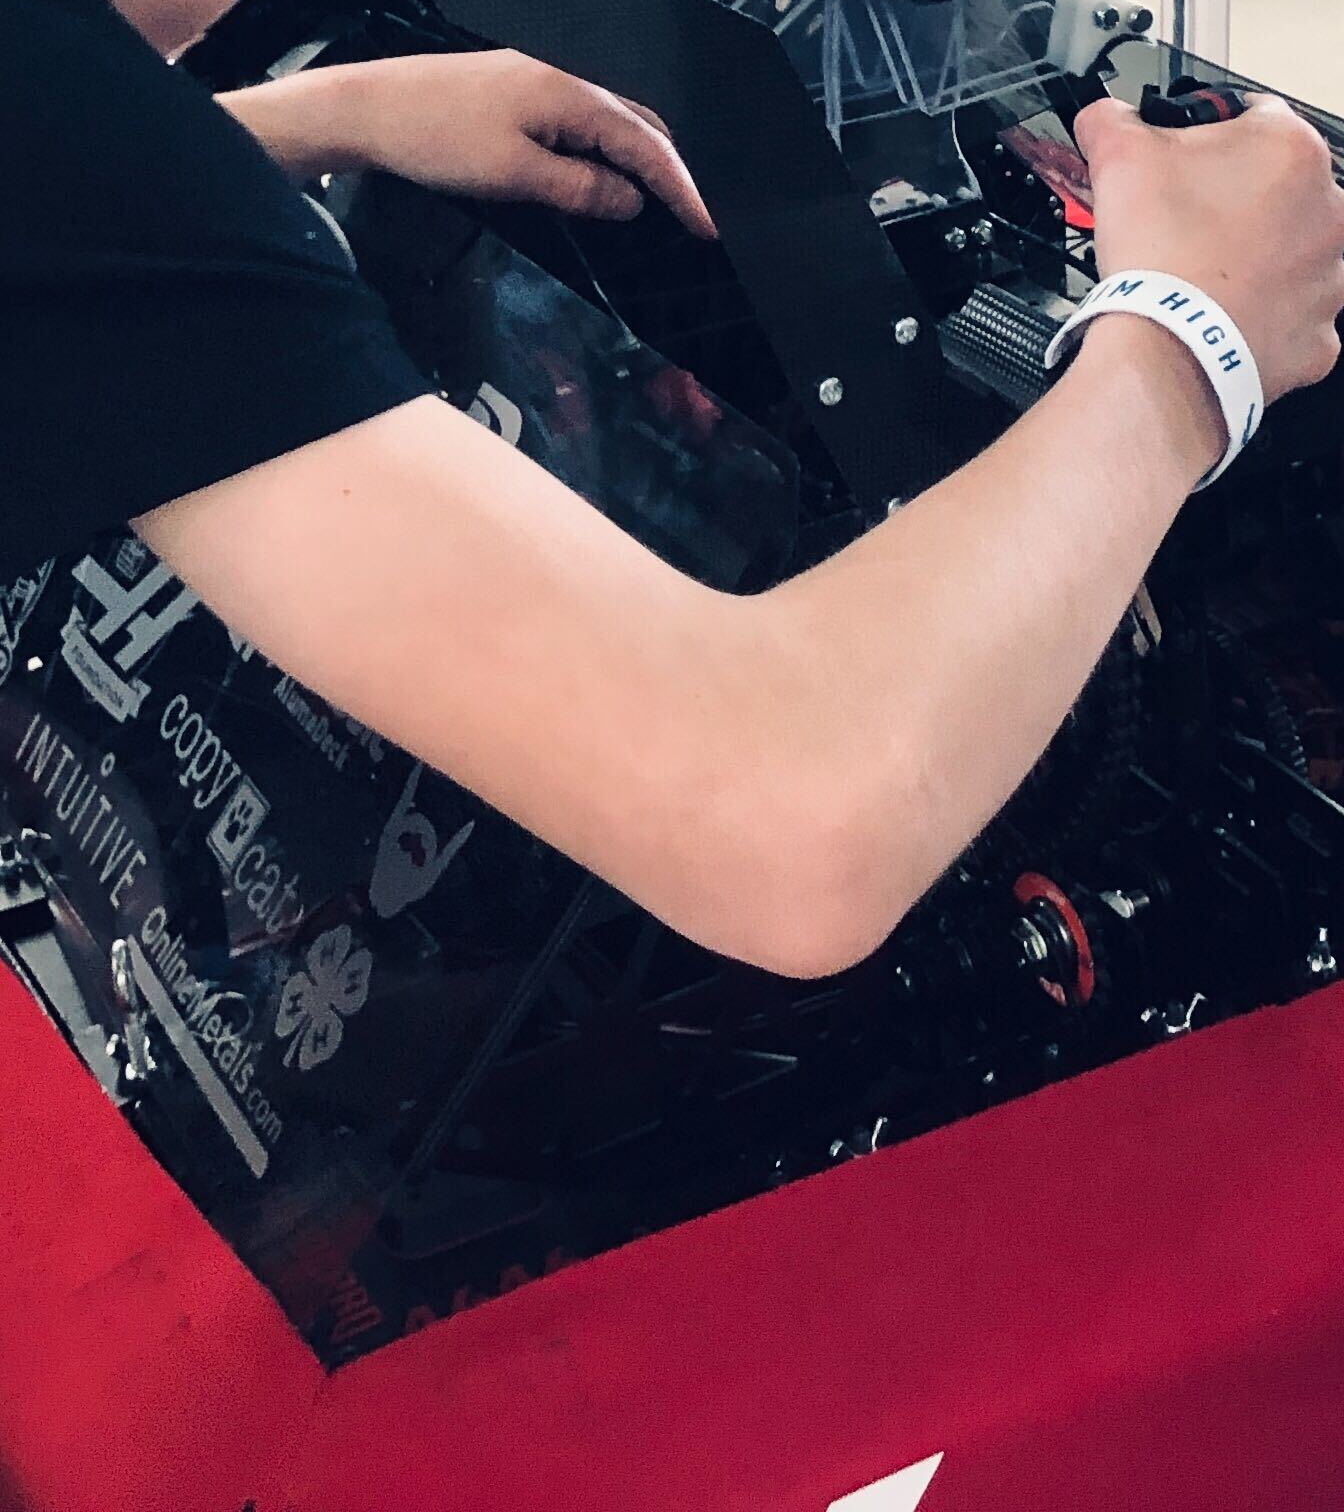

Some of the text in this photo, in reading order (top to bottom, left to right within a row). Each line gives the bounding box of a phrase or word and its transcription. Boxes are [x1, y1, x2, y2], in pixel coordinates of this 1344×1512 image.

[1158, 291, 1242, 372] HIGH
[14, 714, 148, 909] INTUITIVE
[160, 694, 305, 934] copy cat
